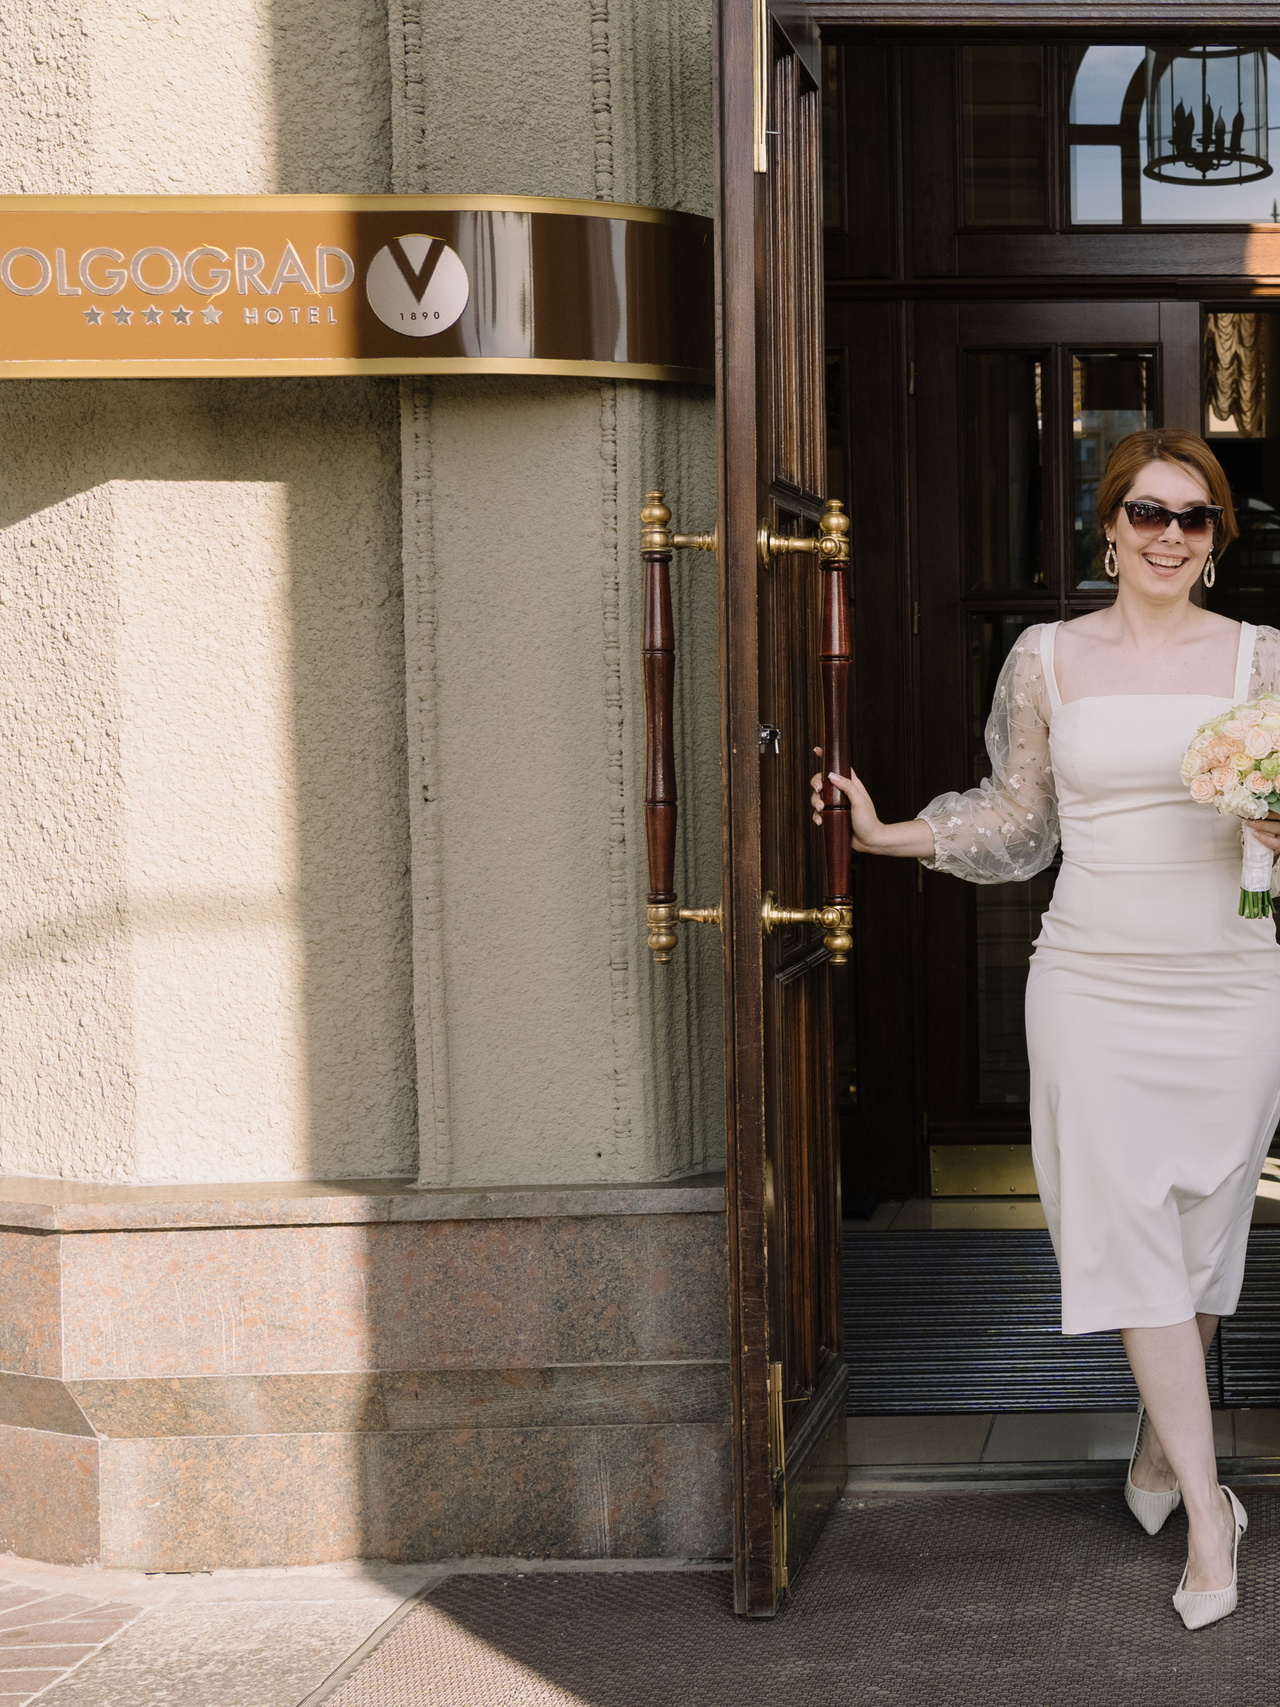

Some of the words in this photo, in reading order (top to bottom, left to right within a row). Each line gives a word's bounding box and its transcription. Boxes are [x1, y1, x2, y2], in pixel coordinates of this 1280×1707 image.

[1, 240, 355, 297] OLGOGRAD
[386, 235, 446, 306] V
[243, 306, 338, 326] HOTEL
[399, 310, 440, 321] 1890
